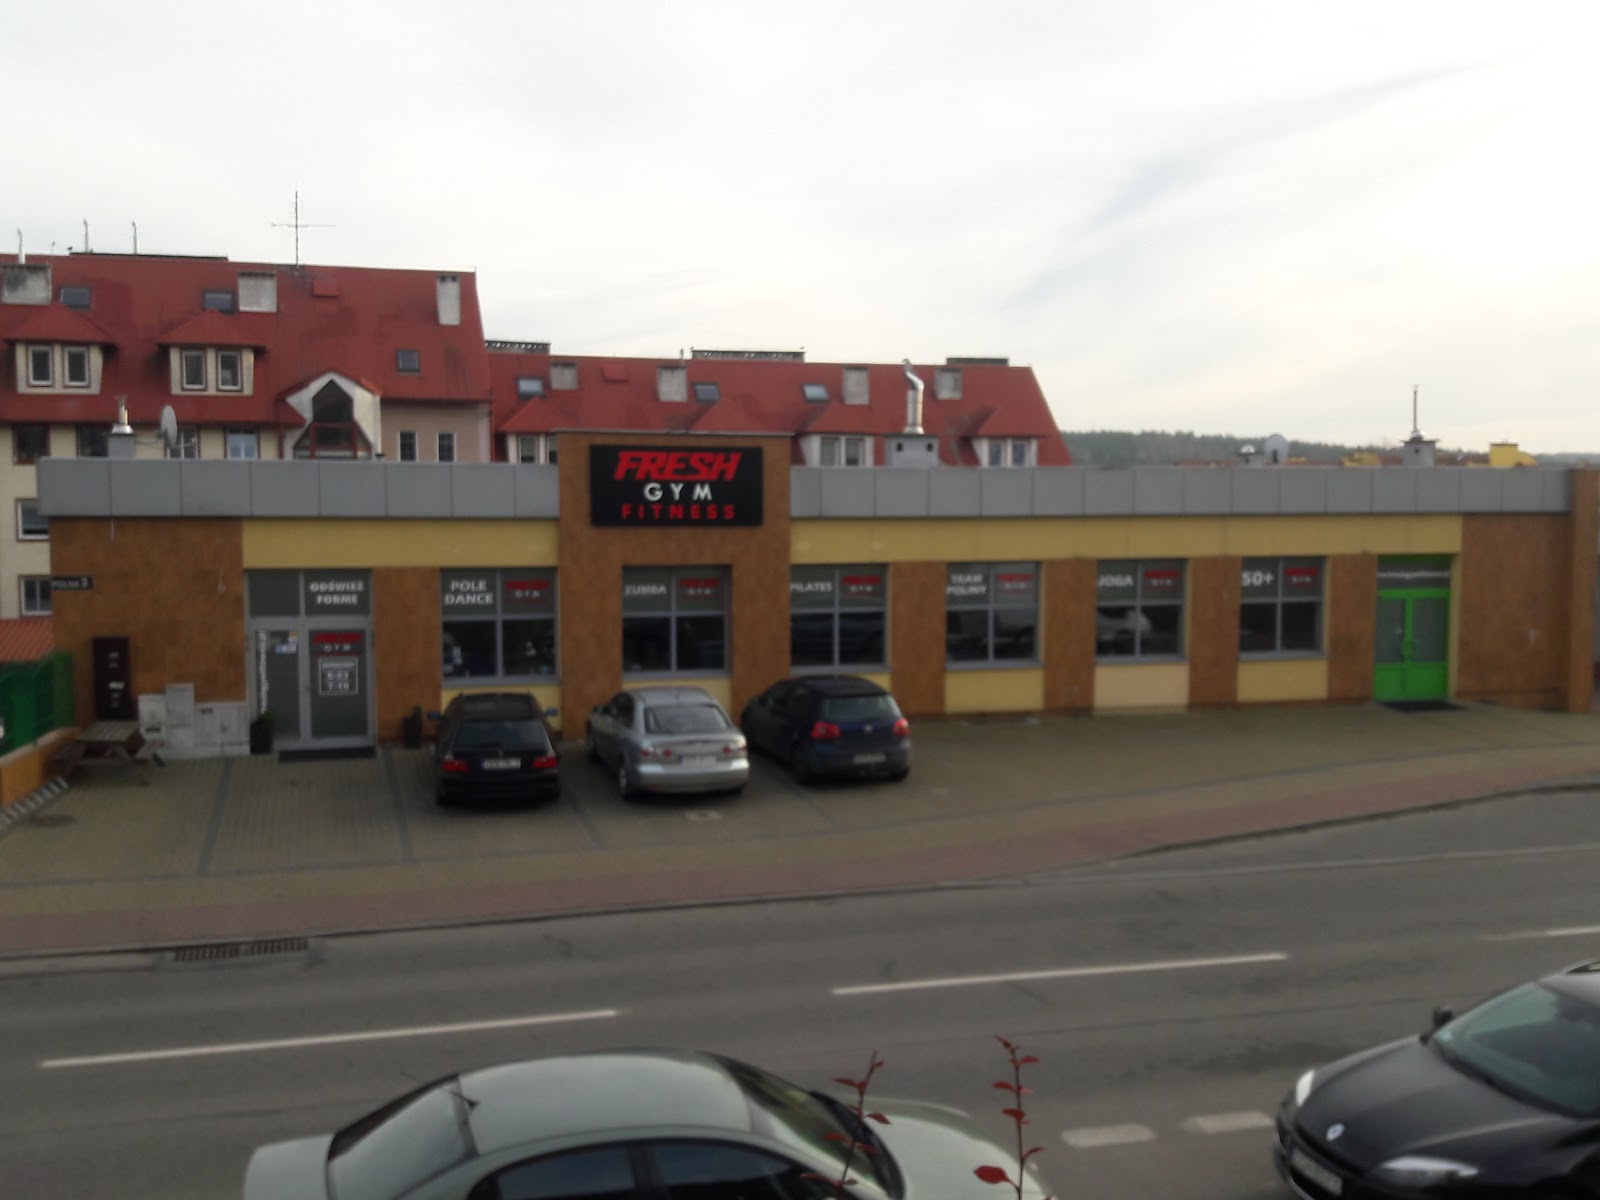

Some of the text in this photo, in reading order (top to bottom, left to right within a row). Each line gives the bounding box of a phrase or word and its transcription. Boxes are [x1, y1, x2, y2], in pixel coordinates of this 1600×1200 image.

[613, 451, 742, 481] FRESH
[643, 482, 712, 502] GYM
[620, 503, 736, 520] FITNESS
[1098, 574, 1133, 587] JOGA
[1241, 570, 1275, 587] 50+
[450, 580, 487, 592] POLE
[624, 584, 667, 596] ZUMBA
[789, 582, 833, 593] PILATES
[444, 592, 494, 605] DANCE
